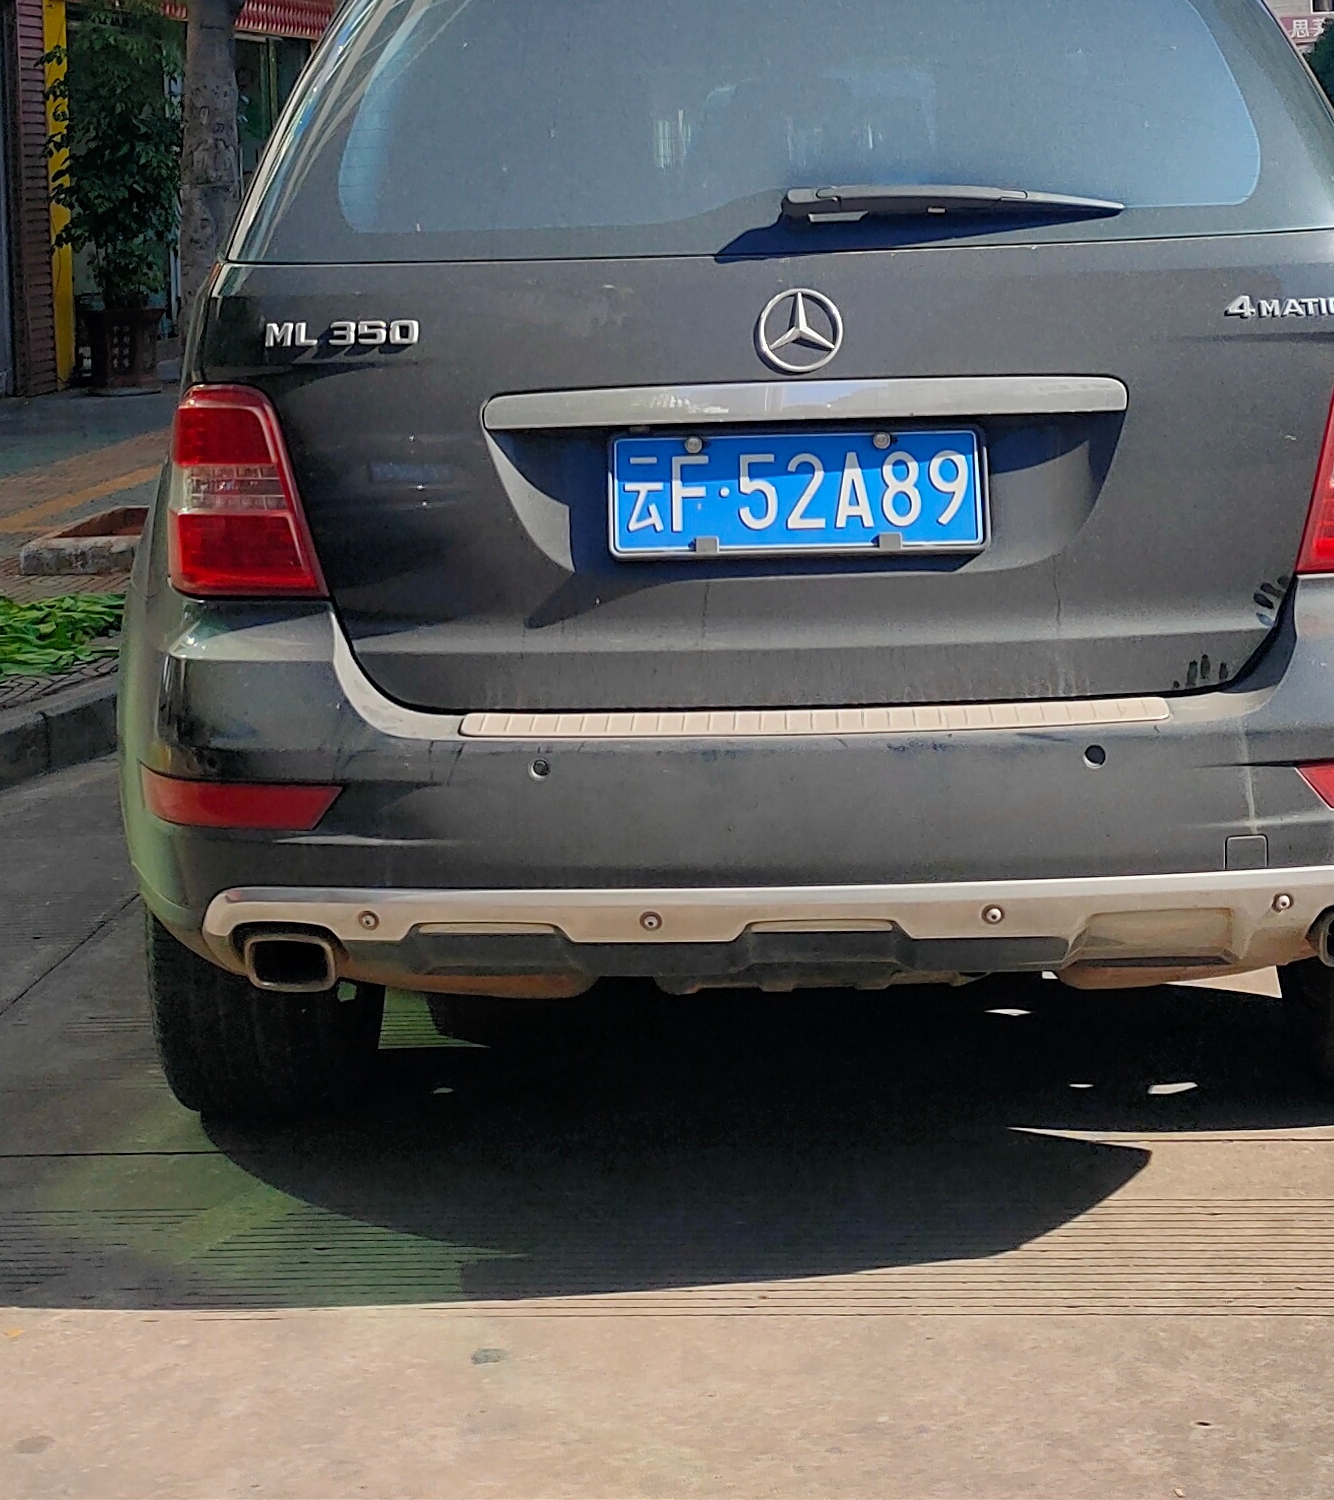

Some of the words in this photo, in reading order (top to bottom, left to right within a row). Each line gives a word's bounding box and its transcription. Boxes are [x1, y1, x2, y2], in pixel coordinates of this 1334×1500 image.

[265, 321, 318, 347] ML
[328, 319, 420, 346] 350
[624, 449, 969, 533] 云F·52A89
